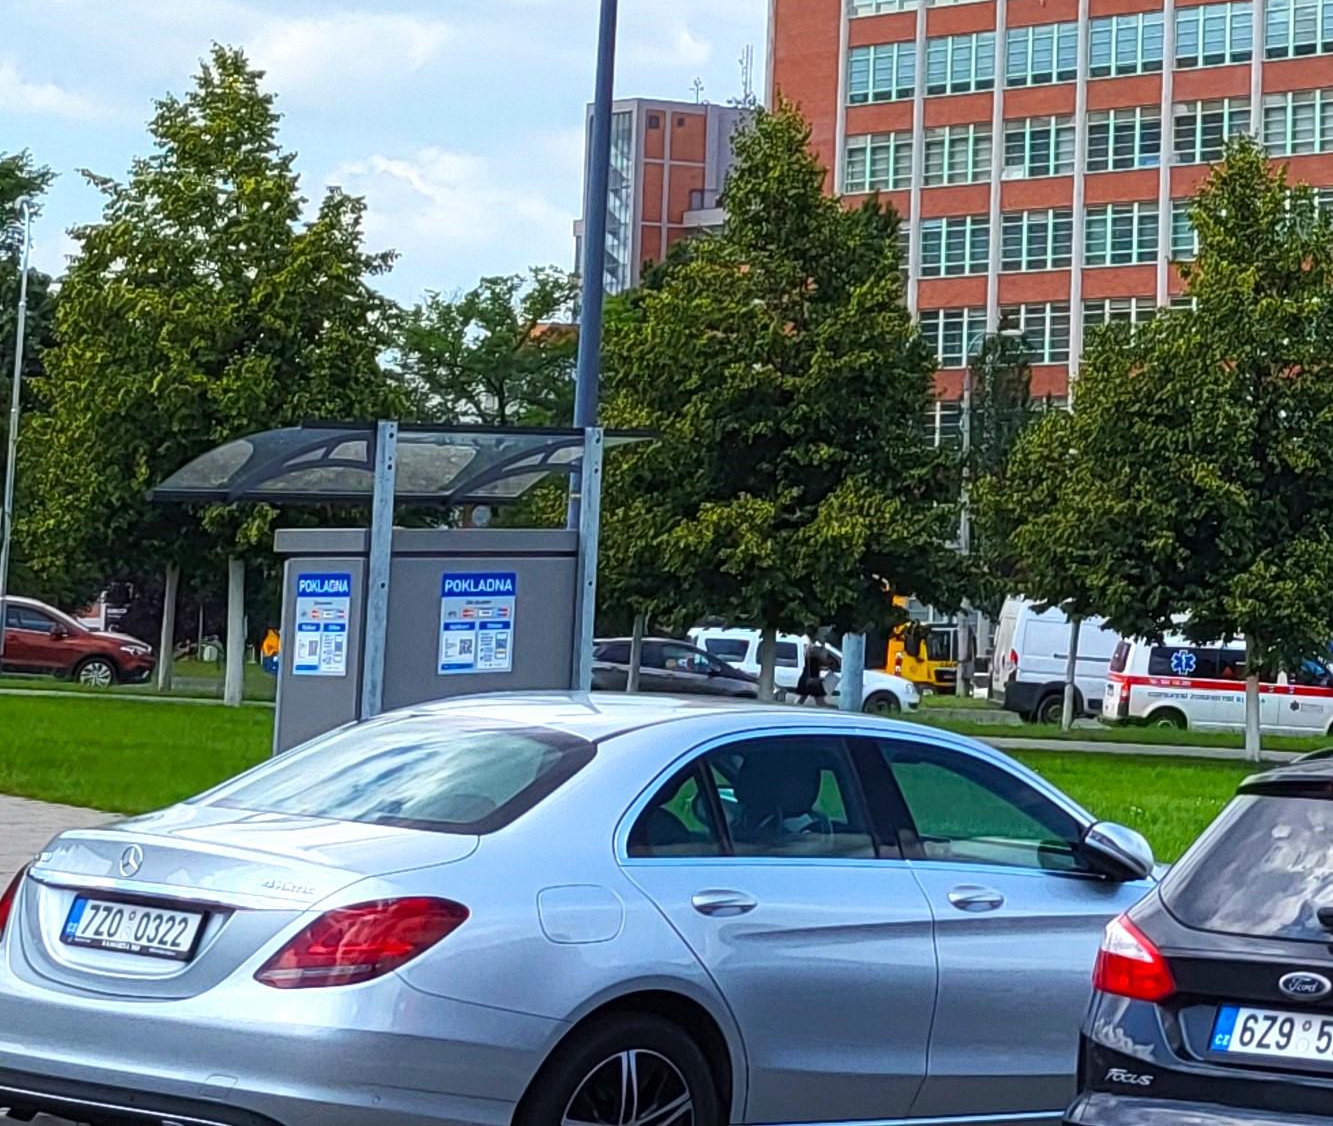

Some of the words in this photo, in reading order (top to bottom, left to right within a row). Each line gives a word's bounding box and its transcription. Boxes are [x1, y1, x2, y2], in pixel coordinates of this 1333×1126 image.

[299, 579, 349, 593] POKLADNA
[444, 578, 513, 593] POKLADNA
[133, 915, 190, 949] 0322
[1288, 976, 1319, 994] Ford
[1214, 1033, 1231, 1047] CZ
[1238, 1013, 1296, 1051] 6Z9
